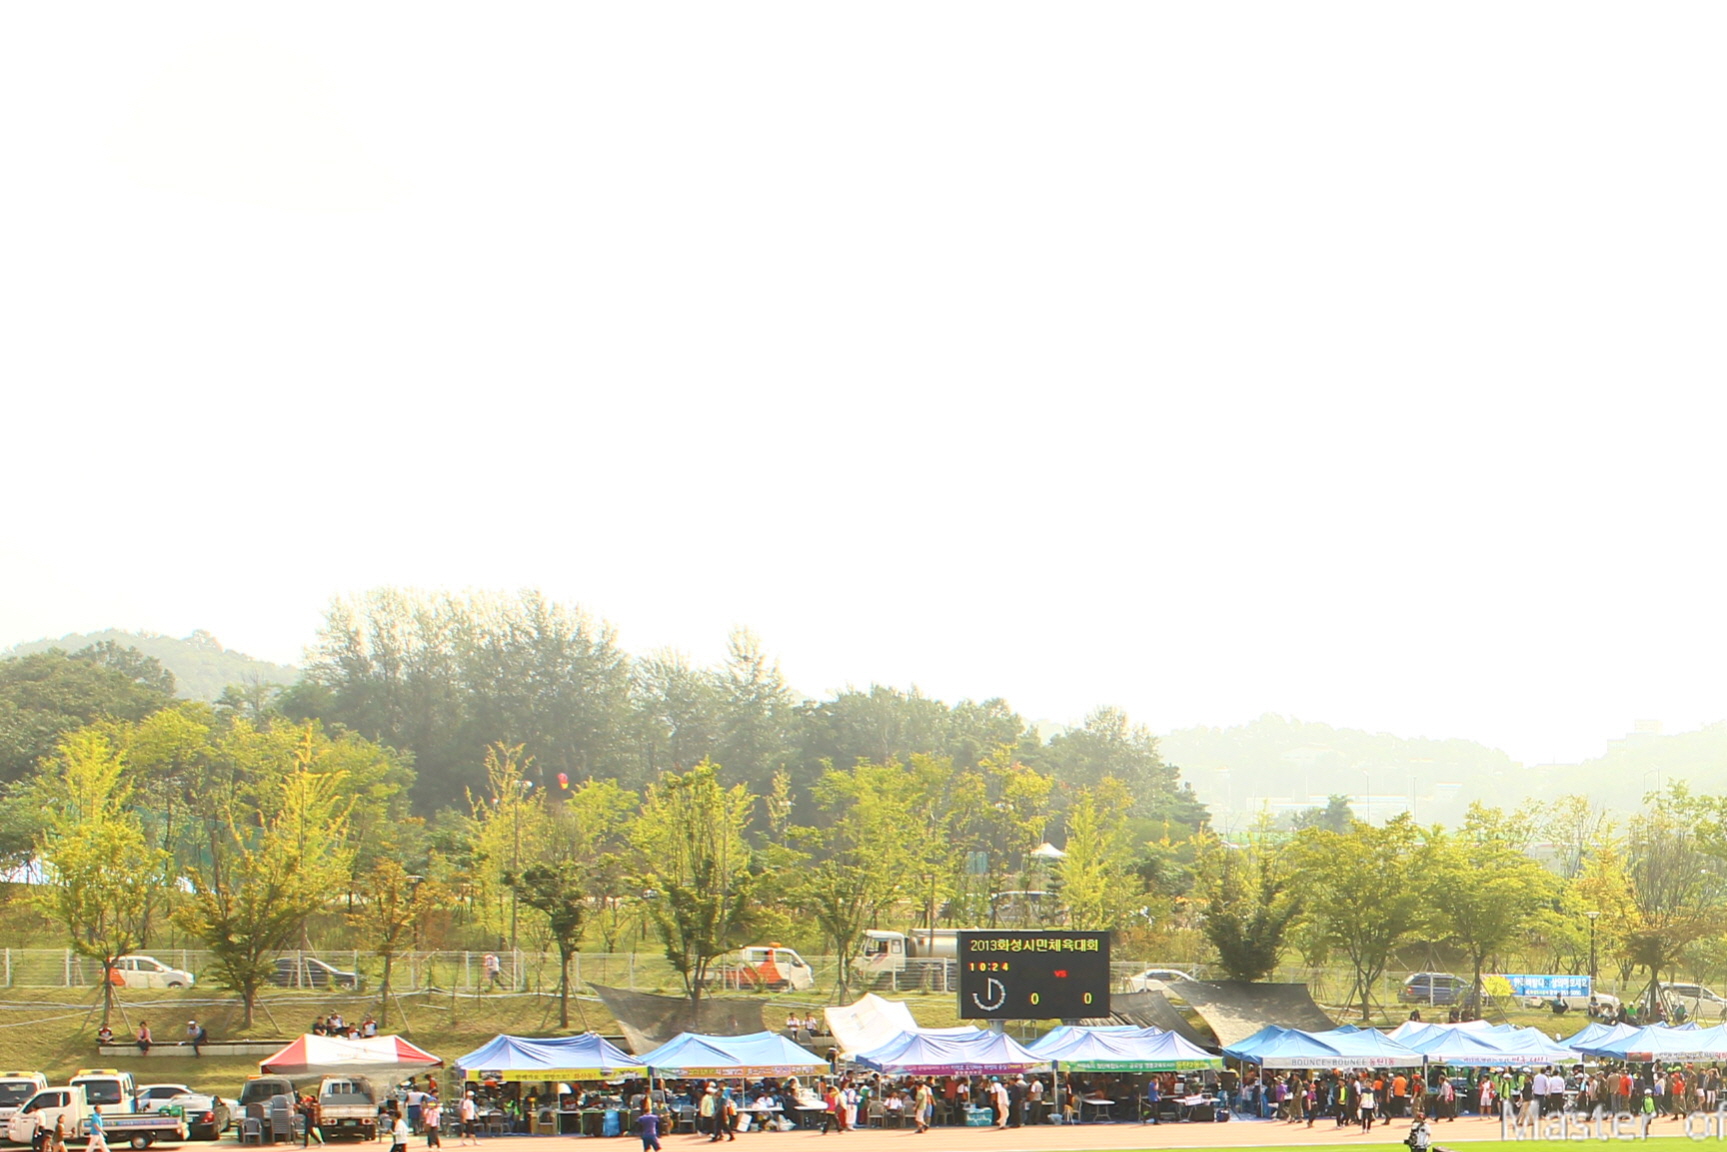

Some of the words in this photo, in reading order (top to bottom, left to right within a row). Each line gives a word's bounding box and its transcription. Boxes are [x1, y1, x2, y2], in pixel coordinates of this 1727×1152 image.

[970, 938, 1099, 953] 2013화성시민체육대회
[968, 962, 1010, 972] 10:24
[1030, 992, 1040, 1006] 0
[1083, 992, 1093, 1005] 0
